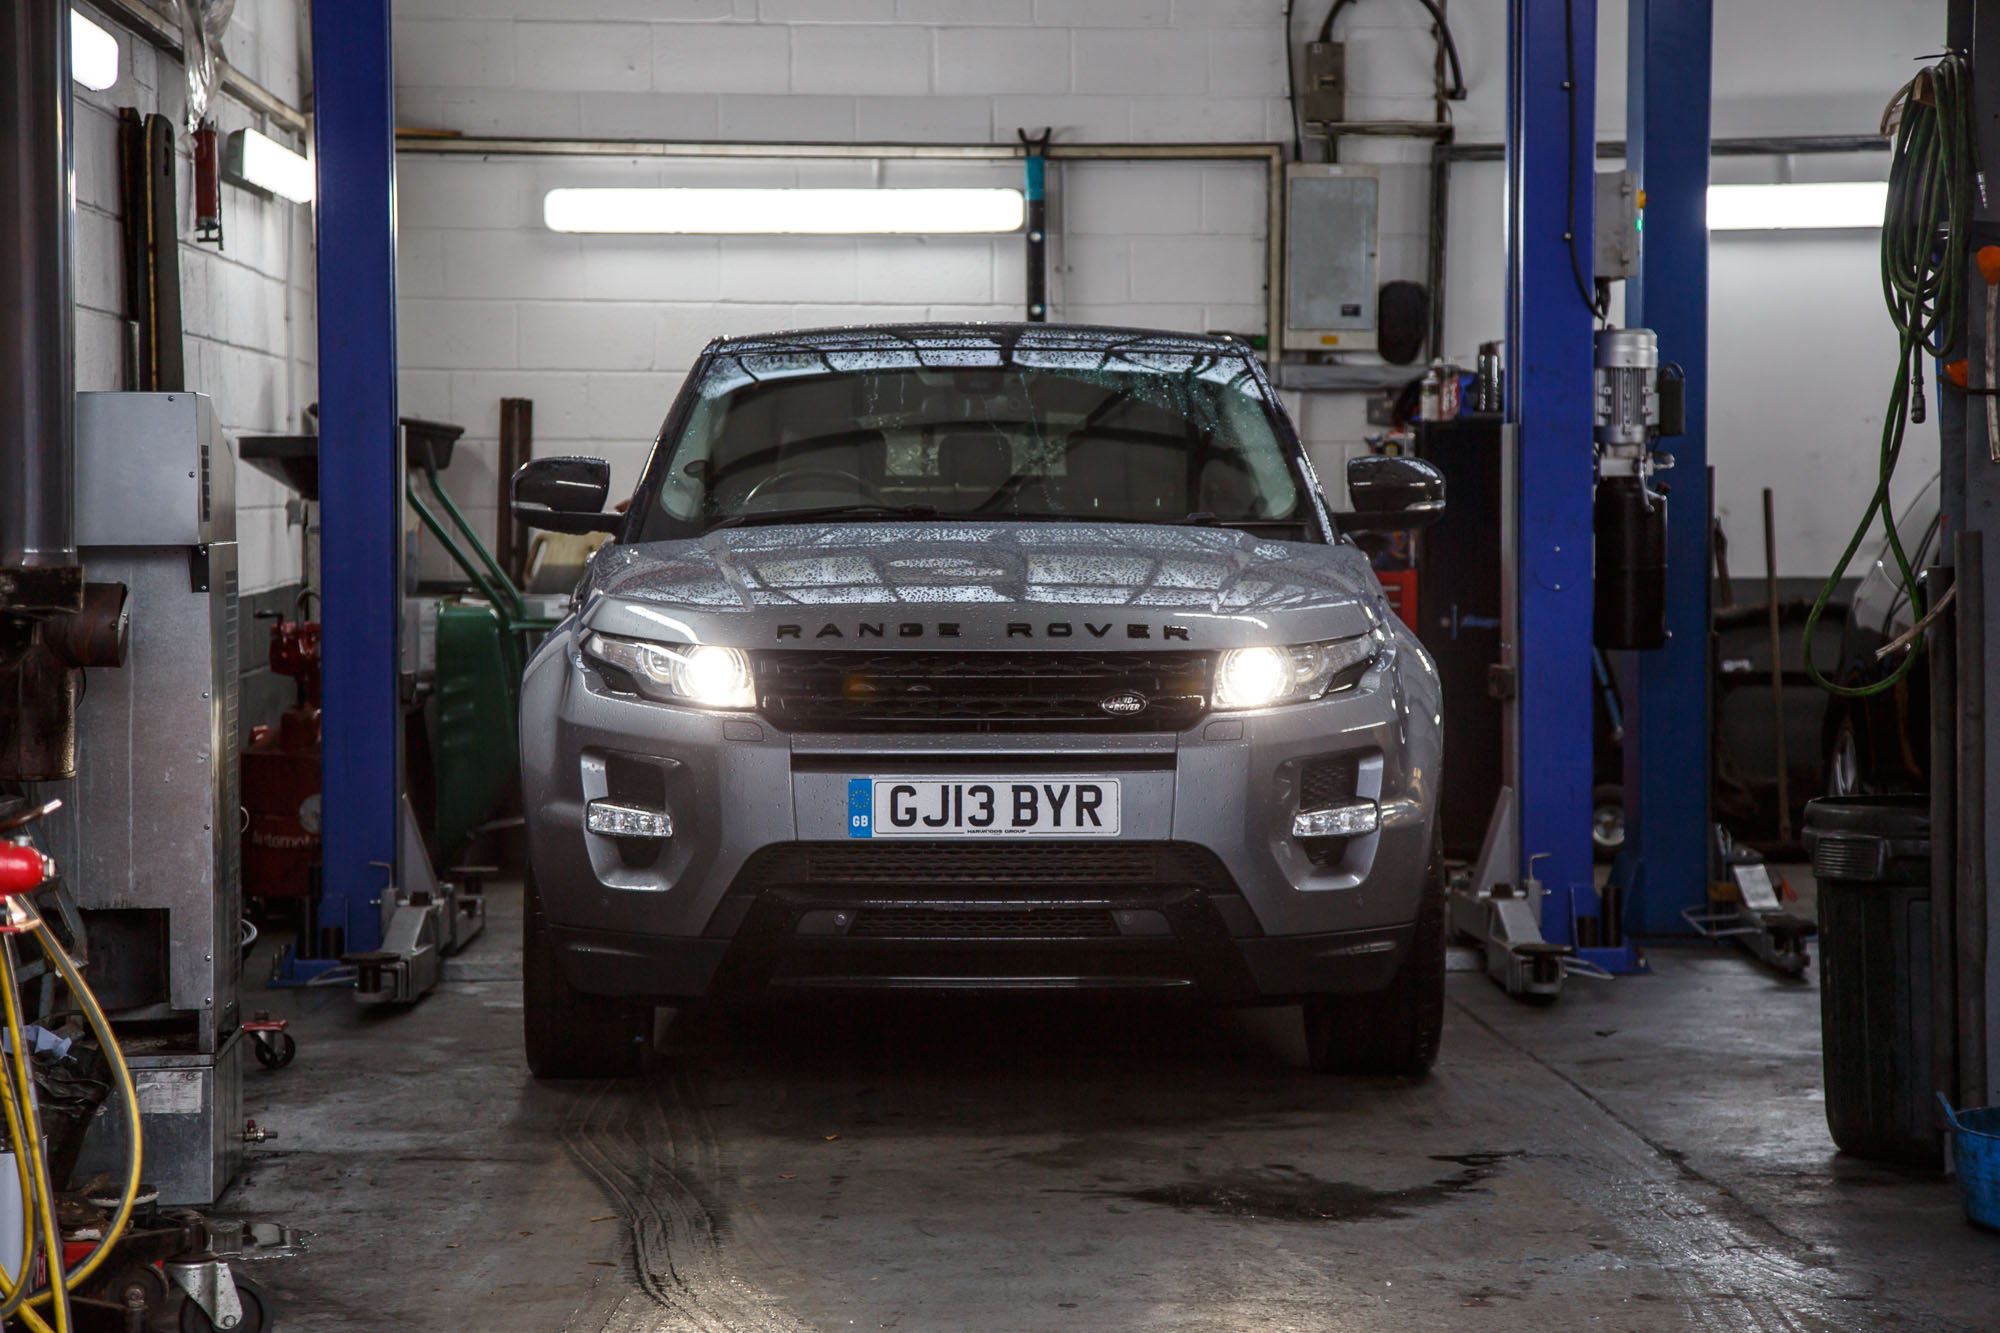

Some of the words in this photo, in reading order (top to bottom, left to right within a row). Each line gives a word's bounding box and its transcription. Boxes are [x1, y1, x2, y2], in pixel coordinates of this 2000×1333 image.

[776, 622, 961, 639] RANGE
[1007, 622, 1191, 641] ROVER
[890, 785, 995, 827] GJ13
[1011, 785, 1103, 827] BYR
[852, 815, 869, 827] GB
